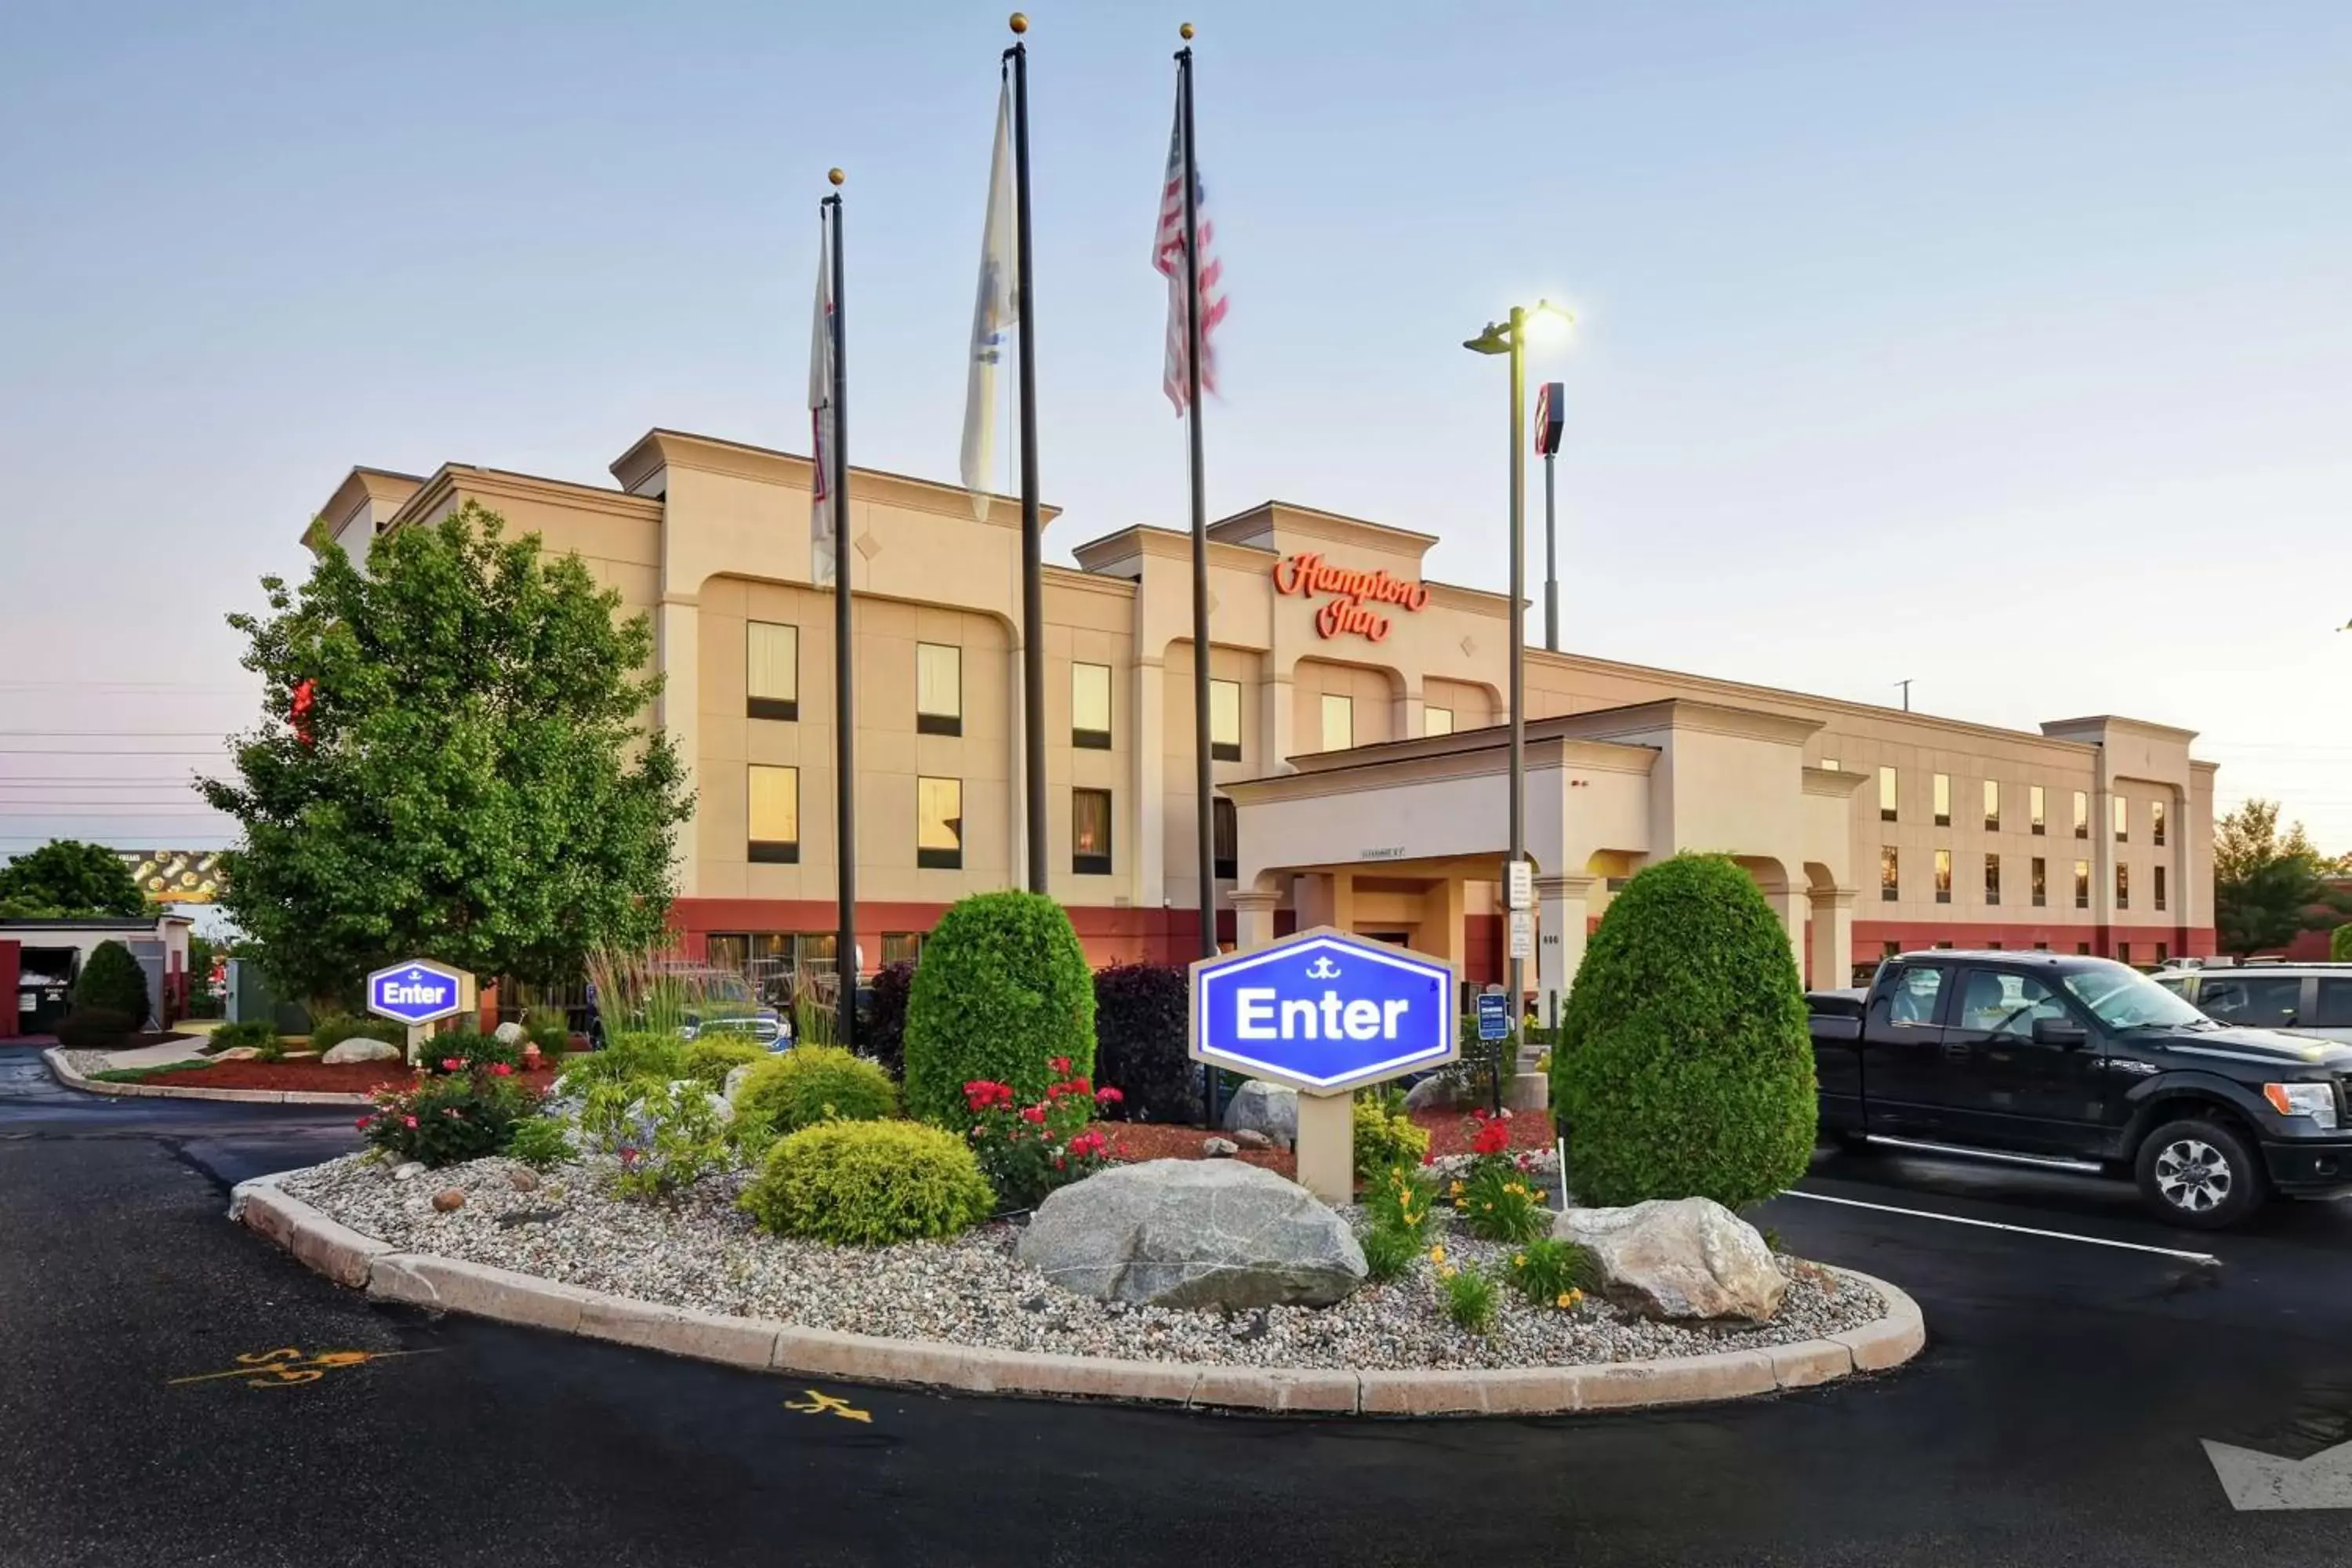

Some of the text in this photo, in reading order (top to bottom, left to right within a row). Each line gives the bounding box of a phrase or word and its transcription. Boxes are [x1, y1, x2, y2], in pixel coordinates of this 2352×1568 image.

[1273, 553, 1429, 612] Hampton
[1316, 597, 1390, 641] Inn
[383, 982, 446, 1004] Enter
[1236, 987, 1409, 1039] Enter
